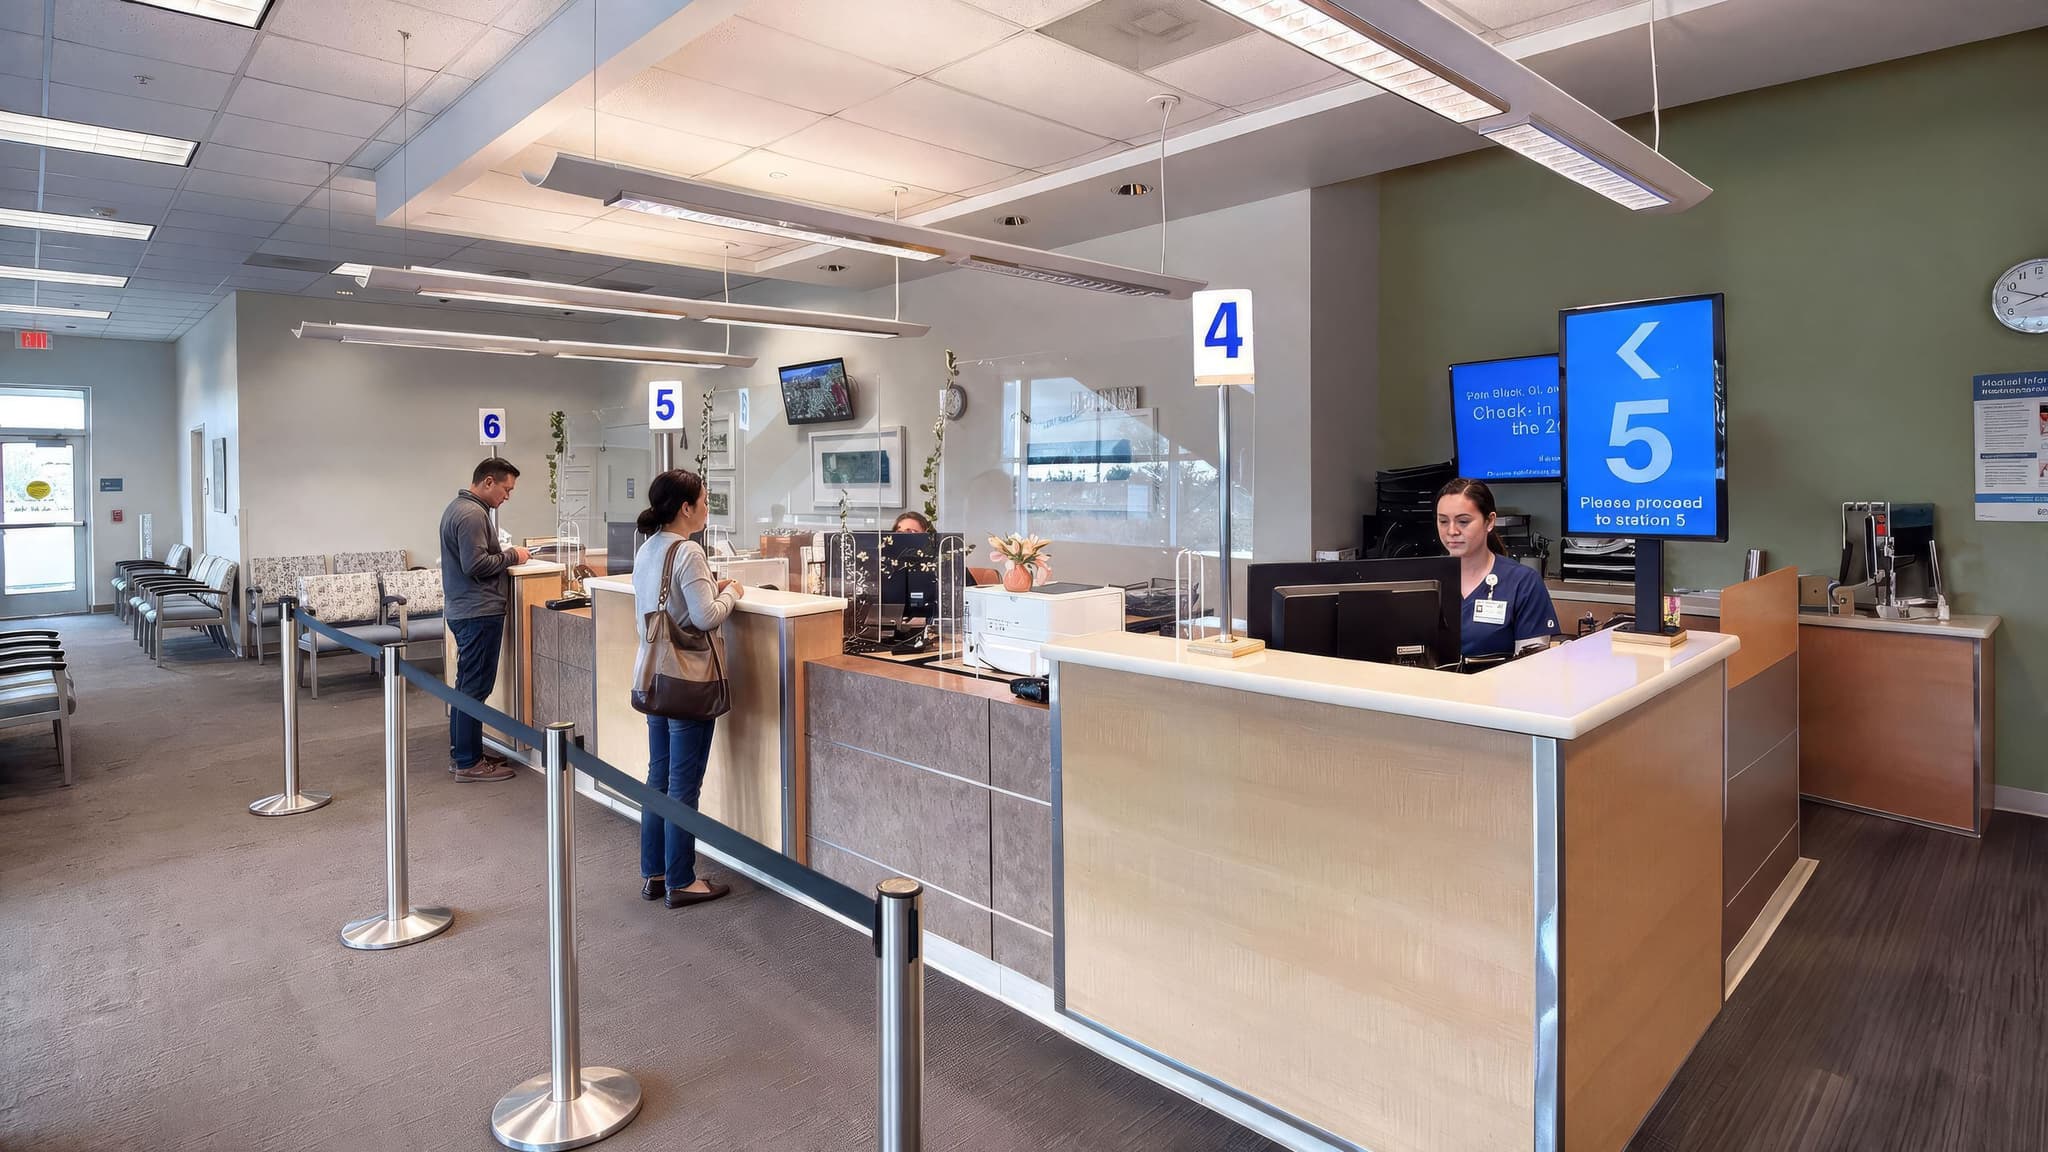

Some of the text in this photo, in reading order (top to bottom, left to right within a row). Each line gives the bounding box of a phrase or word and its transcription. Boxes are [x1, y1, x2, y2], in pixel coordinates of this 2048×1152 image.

[1204, 301, 1243, 359] 4
[656, 389, 675, 421] 5
[483, 413, 501, 439] 6
[1511, 420, 1541, 435] the
[1605, 398, 1674, 485] 5
[1580, 496, 1703, 512] Please proceed
[1595, 513, 1686, 527] to station 5
